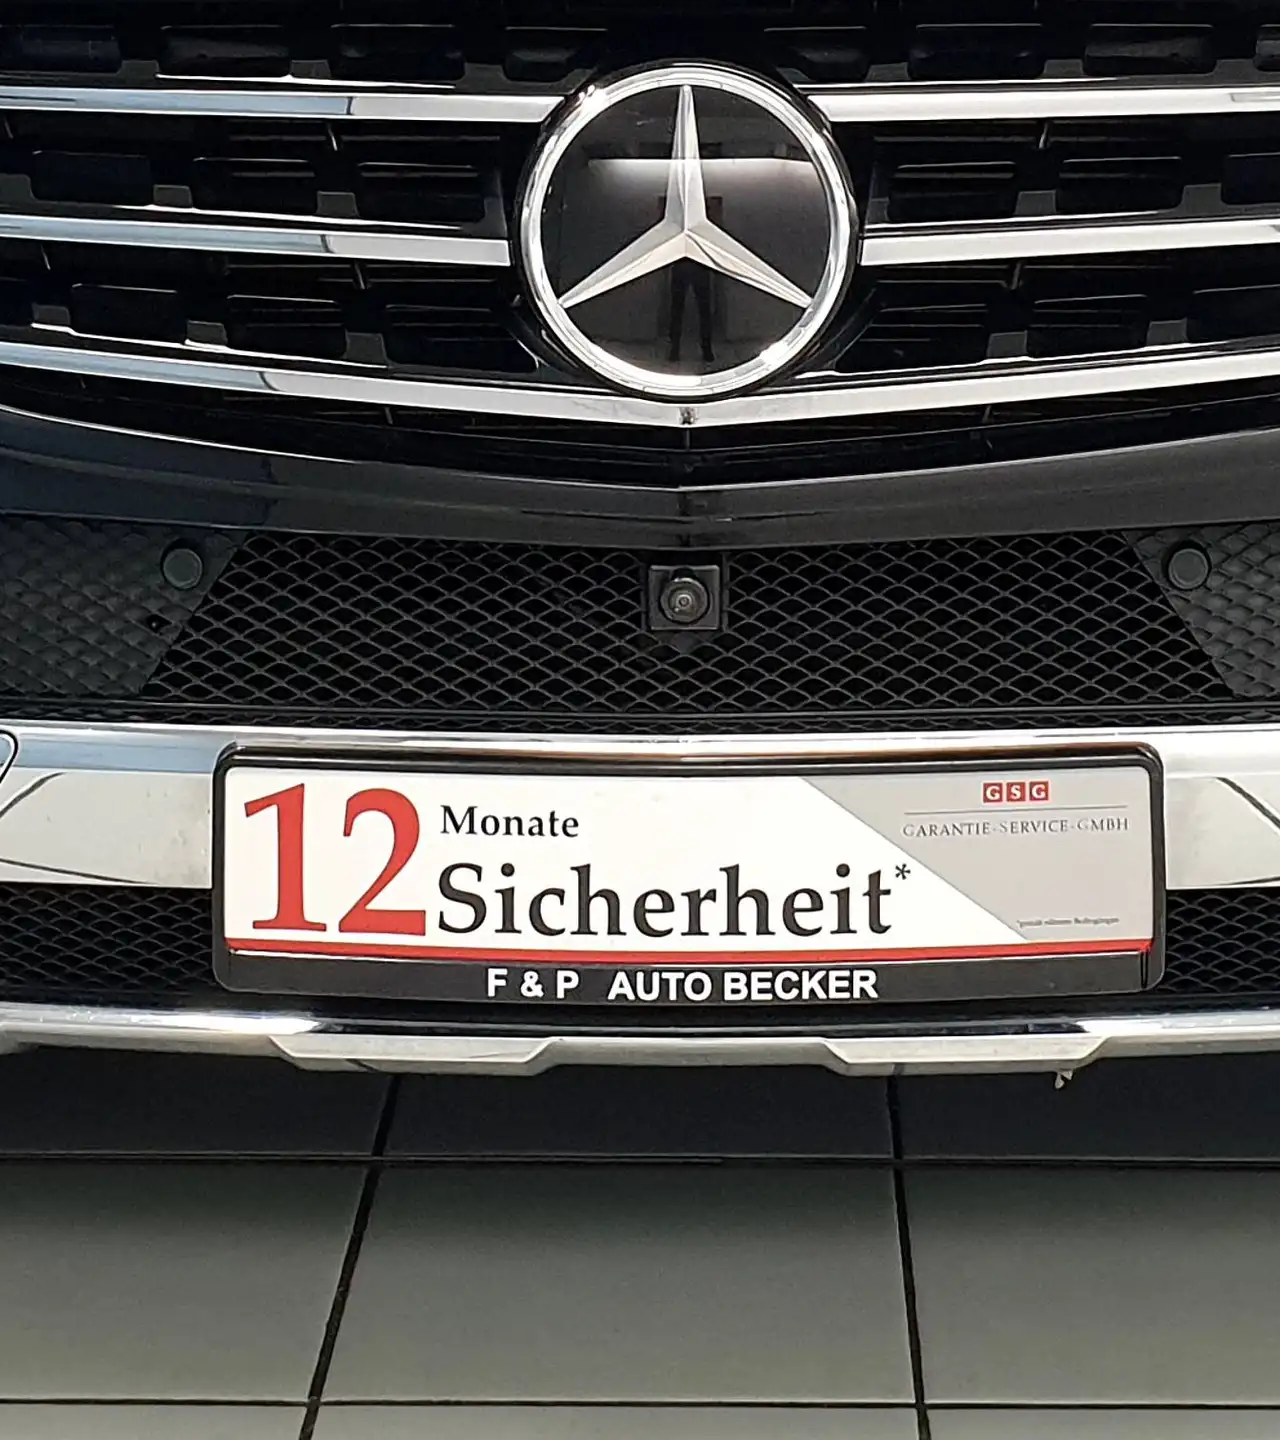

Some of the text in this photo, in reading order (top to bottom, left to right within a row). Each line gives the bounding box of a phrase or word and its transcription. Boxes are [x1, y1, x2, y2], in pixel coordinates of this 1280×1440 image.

[984, 783, 1047, 802] GSG
[441, 804, 580, 839] Monate
[244, 784, 426, 937] 12
[487, 967, 879, 1001] F & P AUTO BECKER
